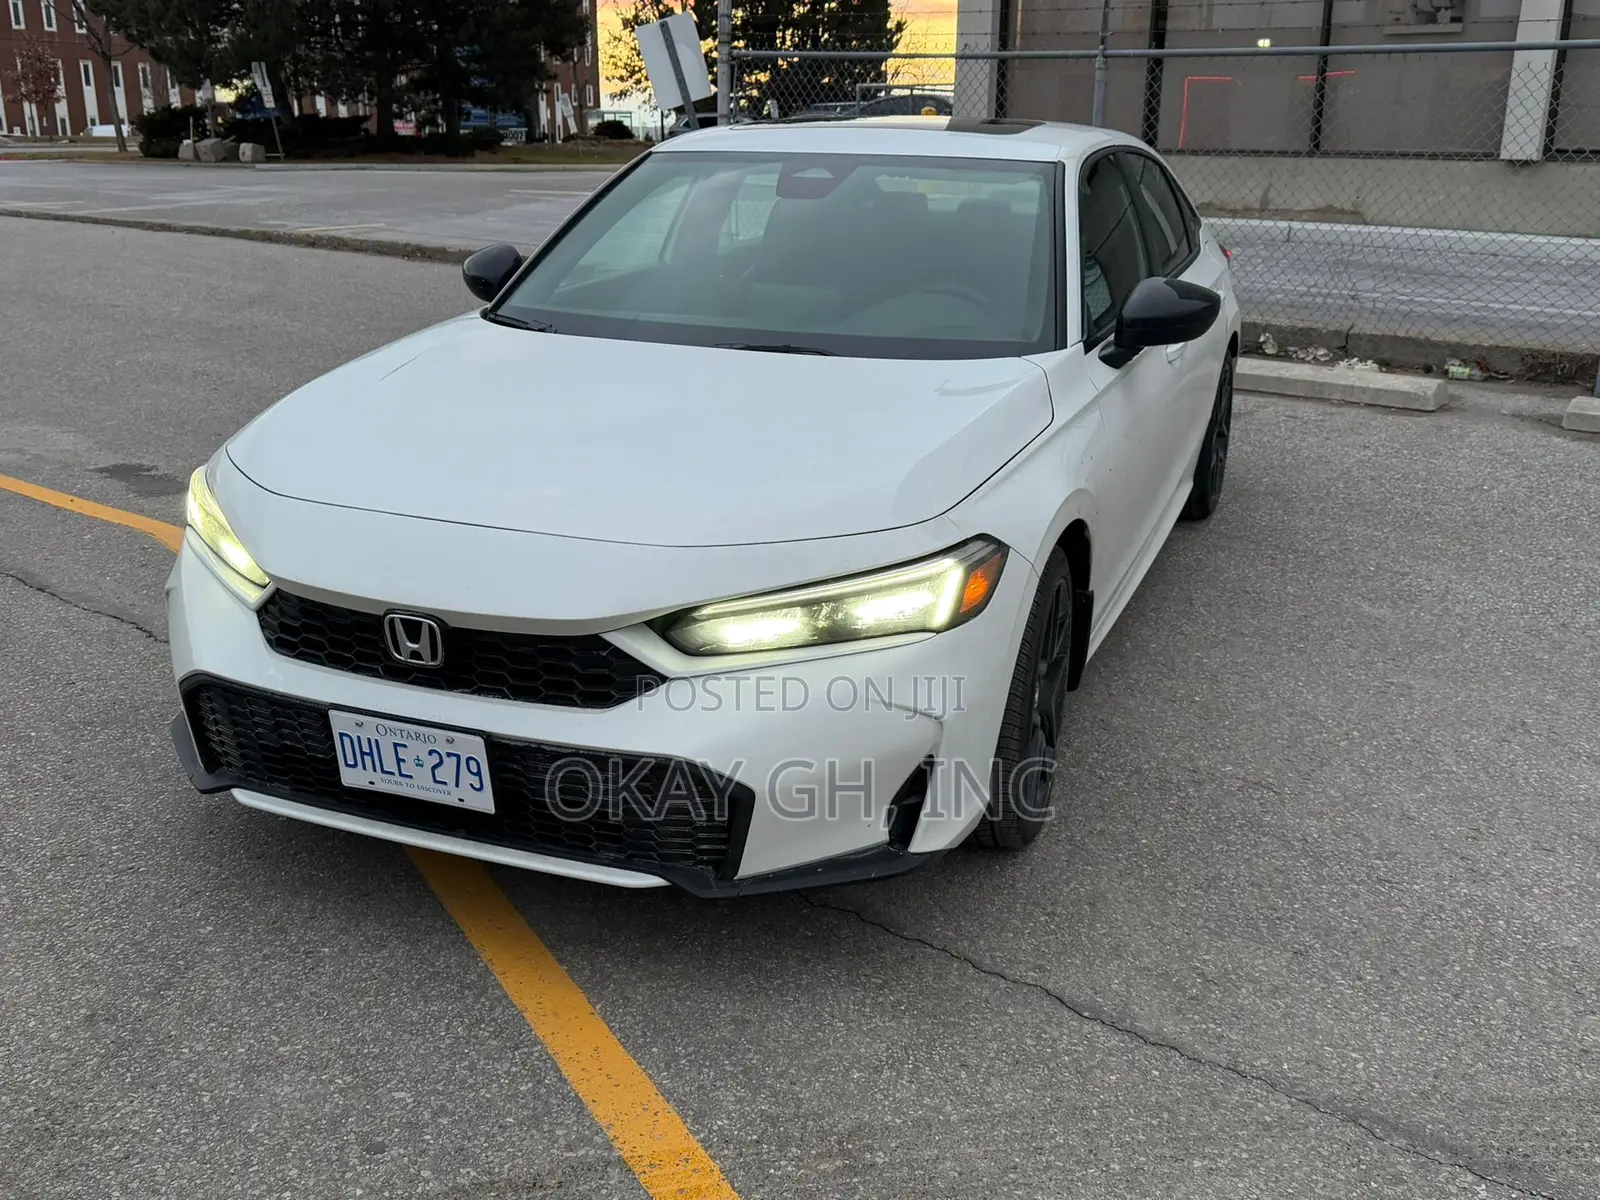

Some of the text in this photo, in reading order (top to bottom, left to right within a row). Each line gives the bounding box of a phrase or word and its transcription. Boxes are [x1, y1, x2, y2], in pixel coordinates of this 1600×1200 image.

[375, 723, 437, 745] ONTARIO
[338, 731, 485, 792] DHLE 279
[380, 777, 403, 787] YOURS
[416, 785, 452, 796] DISCOVER
